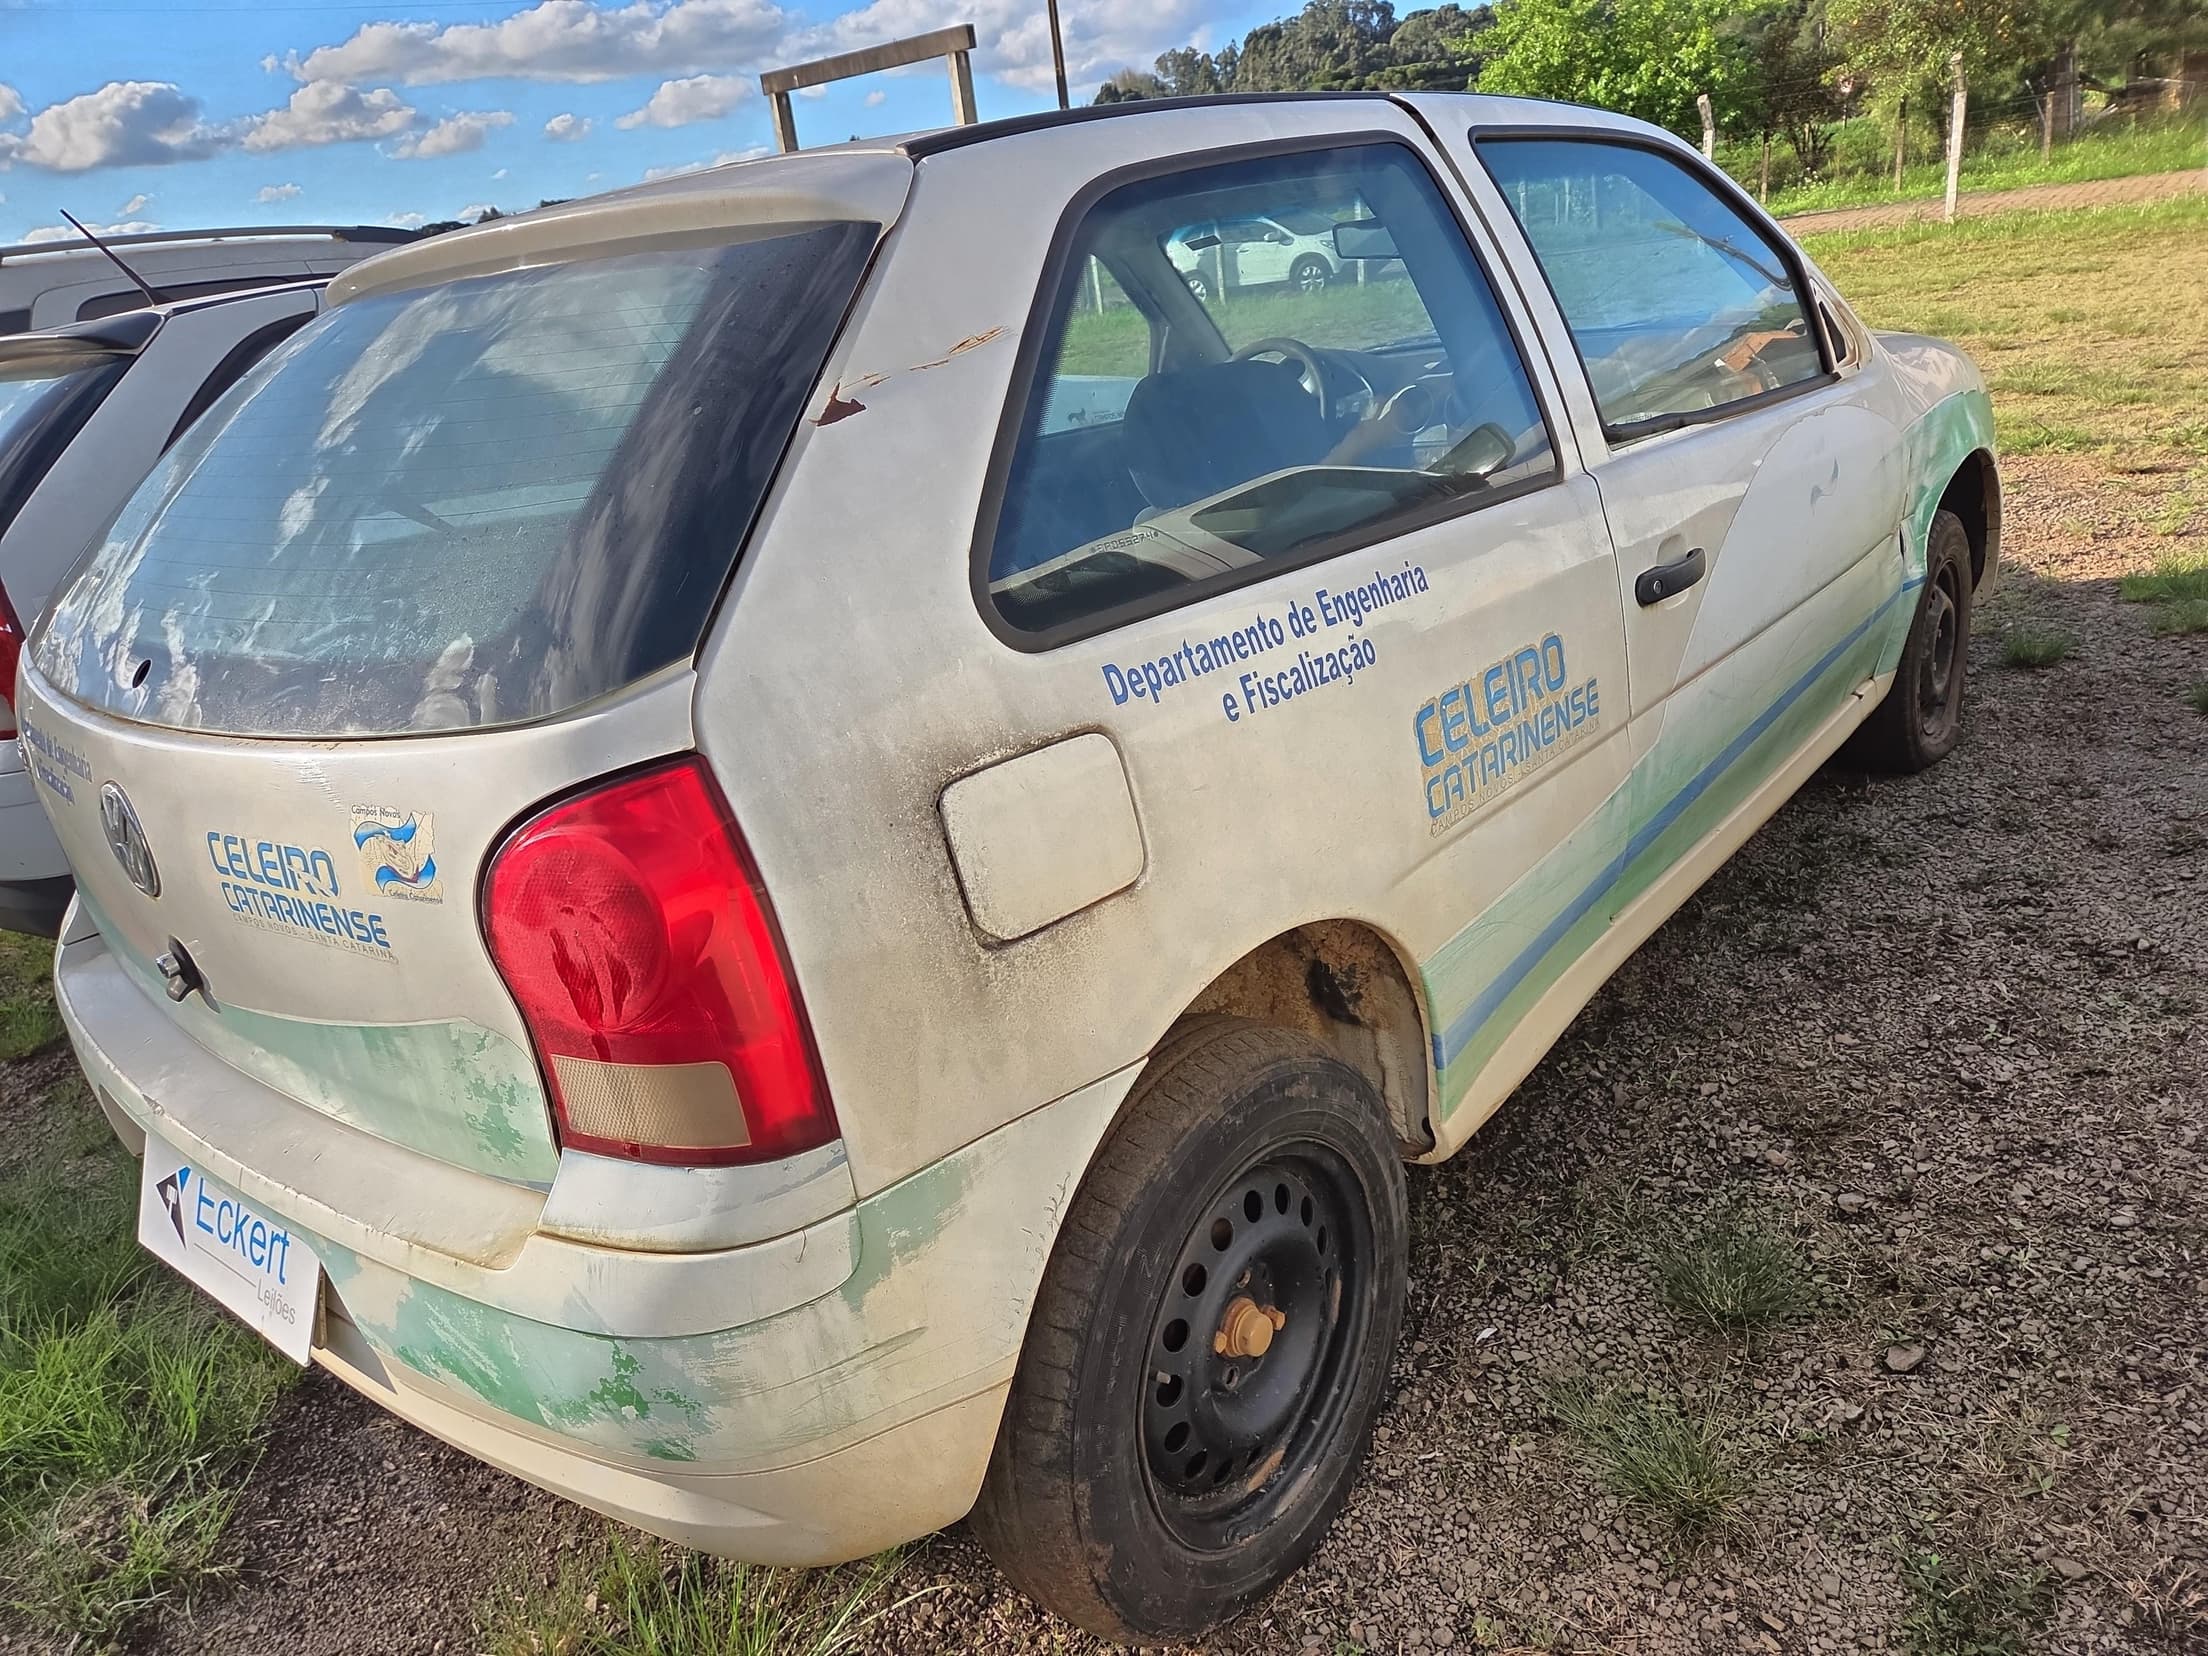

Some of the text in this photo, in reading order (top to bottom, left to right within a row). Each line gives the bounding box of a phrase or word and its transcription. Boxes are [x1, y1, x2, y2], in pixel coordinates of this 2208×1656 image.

[1102, 561, 1429, 704] Departamento de Engenharia
[1222, 634, 1376, 721] e Fiscalização
[1415, 634, 1566, 768] CELEIRO
[1426, 678, 1600, 818] CATARINENSE
[351, 804, 401, 819] Campos Novos
[207, 831, 339, 898] CELEIRO
[221, 881, 391, 949] CATARINENSE
[307, 931, 340, 946] SANTA
[342, 939, 394, 961] CATARINA
[196, 1176, 290, 1285] Eckert
[257, 1278, 297, 1325] Leilões
